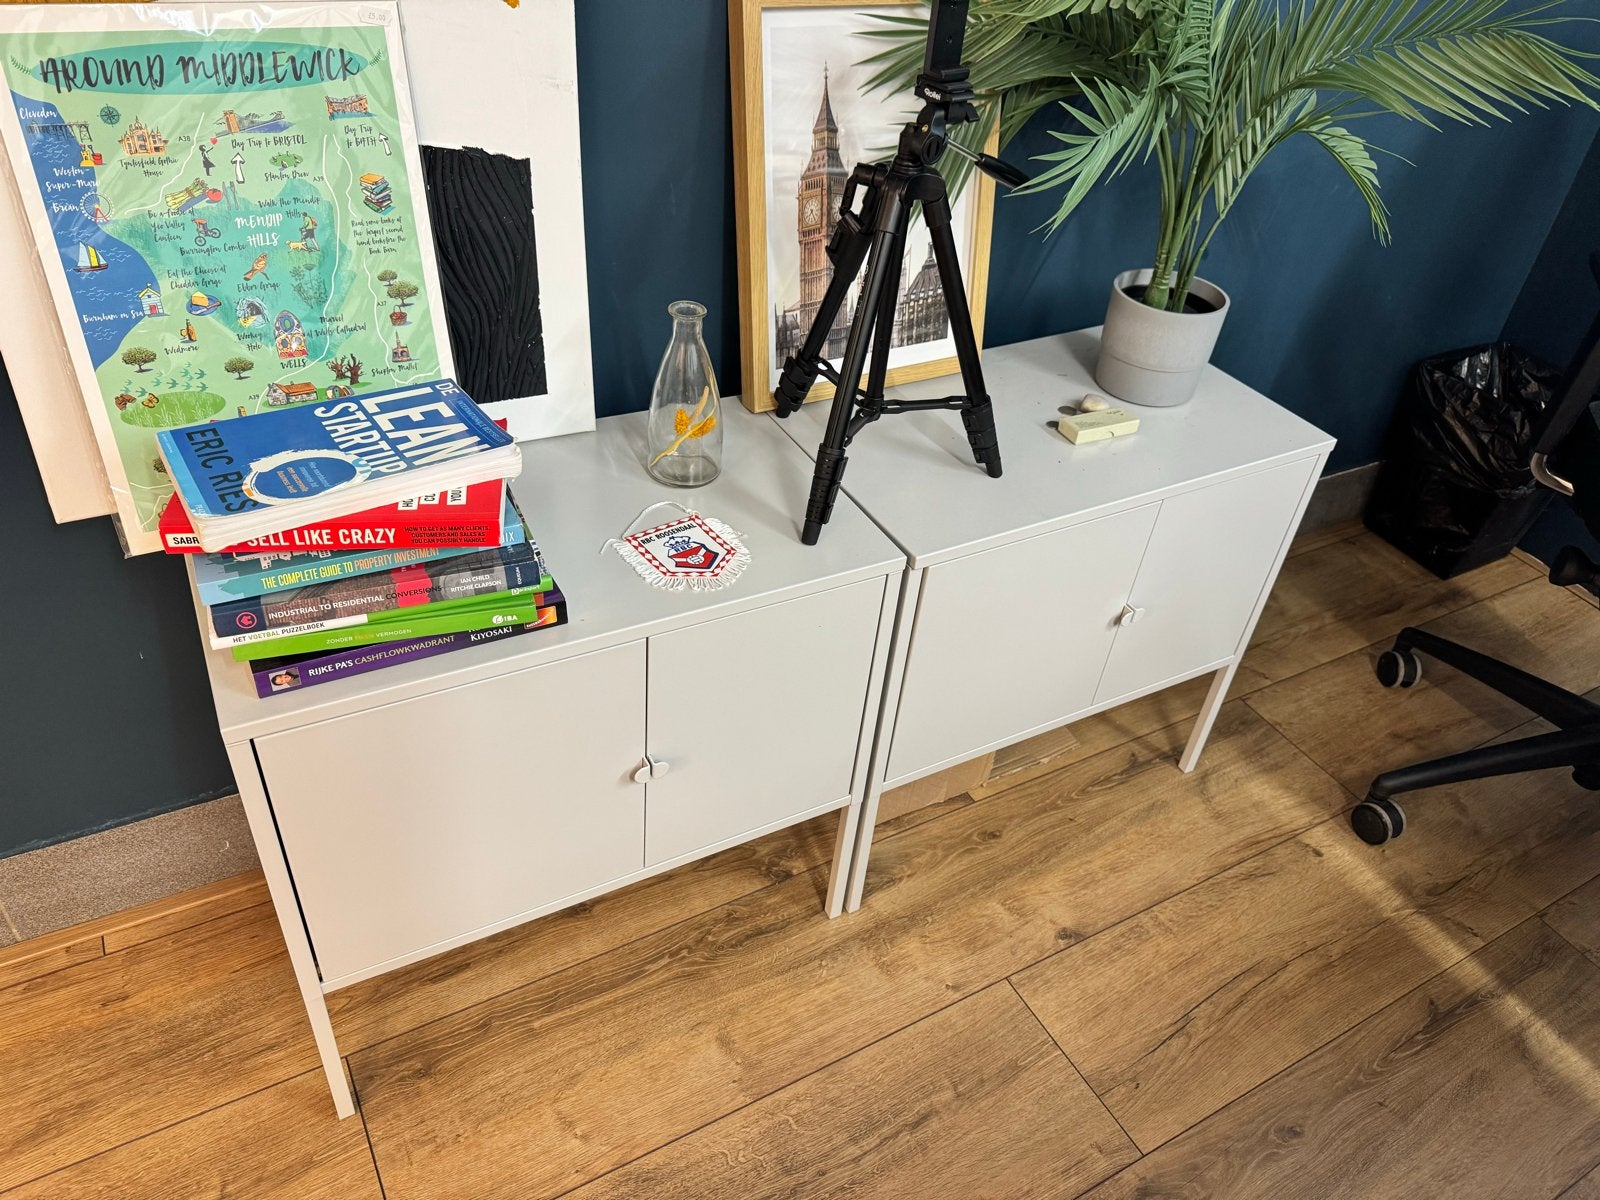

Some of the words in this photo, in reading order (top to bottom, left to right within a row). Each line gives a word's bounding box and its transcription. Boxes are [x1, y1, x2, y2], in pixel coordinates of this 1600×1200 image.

[40, 54, 164, 93] AROUND
[176, 48, 361, 87] MIDDLEWICK
[19, 107, 58, 120] Clevedon
[344, 125, 357, 135] Day
[359, 124, 373, 134] Trip
[231, 138, 246, 149] Day
[247, 138, 262, 149] Trip
[265, 138, 271, 147] to
[273, 134, 307, 146] BRISTOL
[346, 138, 353, 148] to
[158, 157, 178, 166] Gothic
[143, 170, 164, 178] House
[258, 198, 278, 209] Walk
[279, 197, 292, 206] the
[166, 220, 185, 231] Valley
[234, 212, 283, 229] MENDIP
[246, 232, 280, 248] HILLS
[180, 244, 221, 256] Burrington
[223, 242, 247, 253] Combe
[167, 269, 179, 279] Eat
[181, 267, 193, 277] the
[194, 266, 218, 276] Cheese
[170, 280, 200, 290] Cheddar
[201, 278, 223, 289] Gorge
[259, 281, 281, 293] Gorge
[82, 313, 119, 324] Burnham
[131, 309, 145, 320] Sea
[336, 322, 367, 335] Cathedral
[236, 332, 262, 344] Wookey
[164, 345, 200, 355] Wedmore
[247, 343, 262, 352] Hole
[280, 358, 308, 370] WELLS
[436, 383, 460, 397] DE
[361, 387, 491, 466] LEAN
[314, 402, 409, 476] STARTUP
[186, 427, 234, 469] ERIC
[209, 471, 258, 512] RIES
[173, 536, 200, 545] SABR
[247, 530, 290, 547] SELL
[293, 529, 333, 545] LIKE
[339, 527, 396, 544] CRAZY
[501, 531, 515, 542] IX
[640, 536, 656, 545] RBC
[656, 522, 697, 540] ROOSENDAAL
[261, 577, 278, 589] THE
[278, 569, 319, 587] COMPLETE
[319, 564, 342, 579] GUIDE
[342, 561, 354, 575] TO
[354, 554, 392, 569] PROPERTY
[393, 547, 440, 563] INVESTMENT
[450, 583, 473, 593] RITCHIE
[473, 579, 502, 590] CLAPSON
[460, 576, 471, 584] IAN
[471, 574, 490, 582] CHILD
[268, 605, 318, 620] INDUSTRIAL
[319, 602, 331, 611] TO
[332, 594, 385, 609] RESIDENTIAL
[385, 585, 442, 600] CONVERSIONS
[233, 636, 246, 644] HET
[247, 630, 280, 641] VOETBAL
[281, 622, 325, 635] PUZZELBOEK
[326, 636, 353, 644] ZONDER
[375, 629, 412, 638] VERMOGEN
[470, 625, 513, 642] KIYOSAKI
[308, 662, 334, 677] RIJKE
[334, 658, 354, 671] PA'S
[354, 635, 455, 666] CASHFLOWKWADRANT
